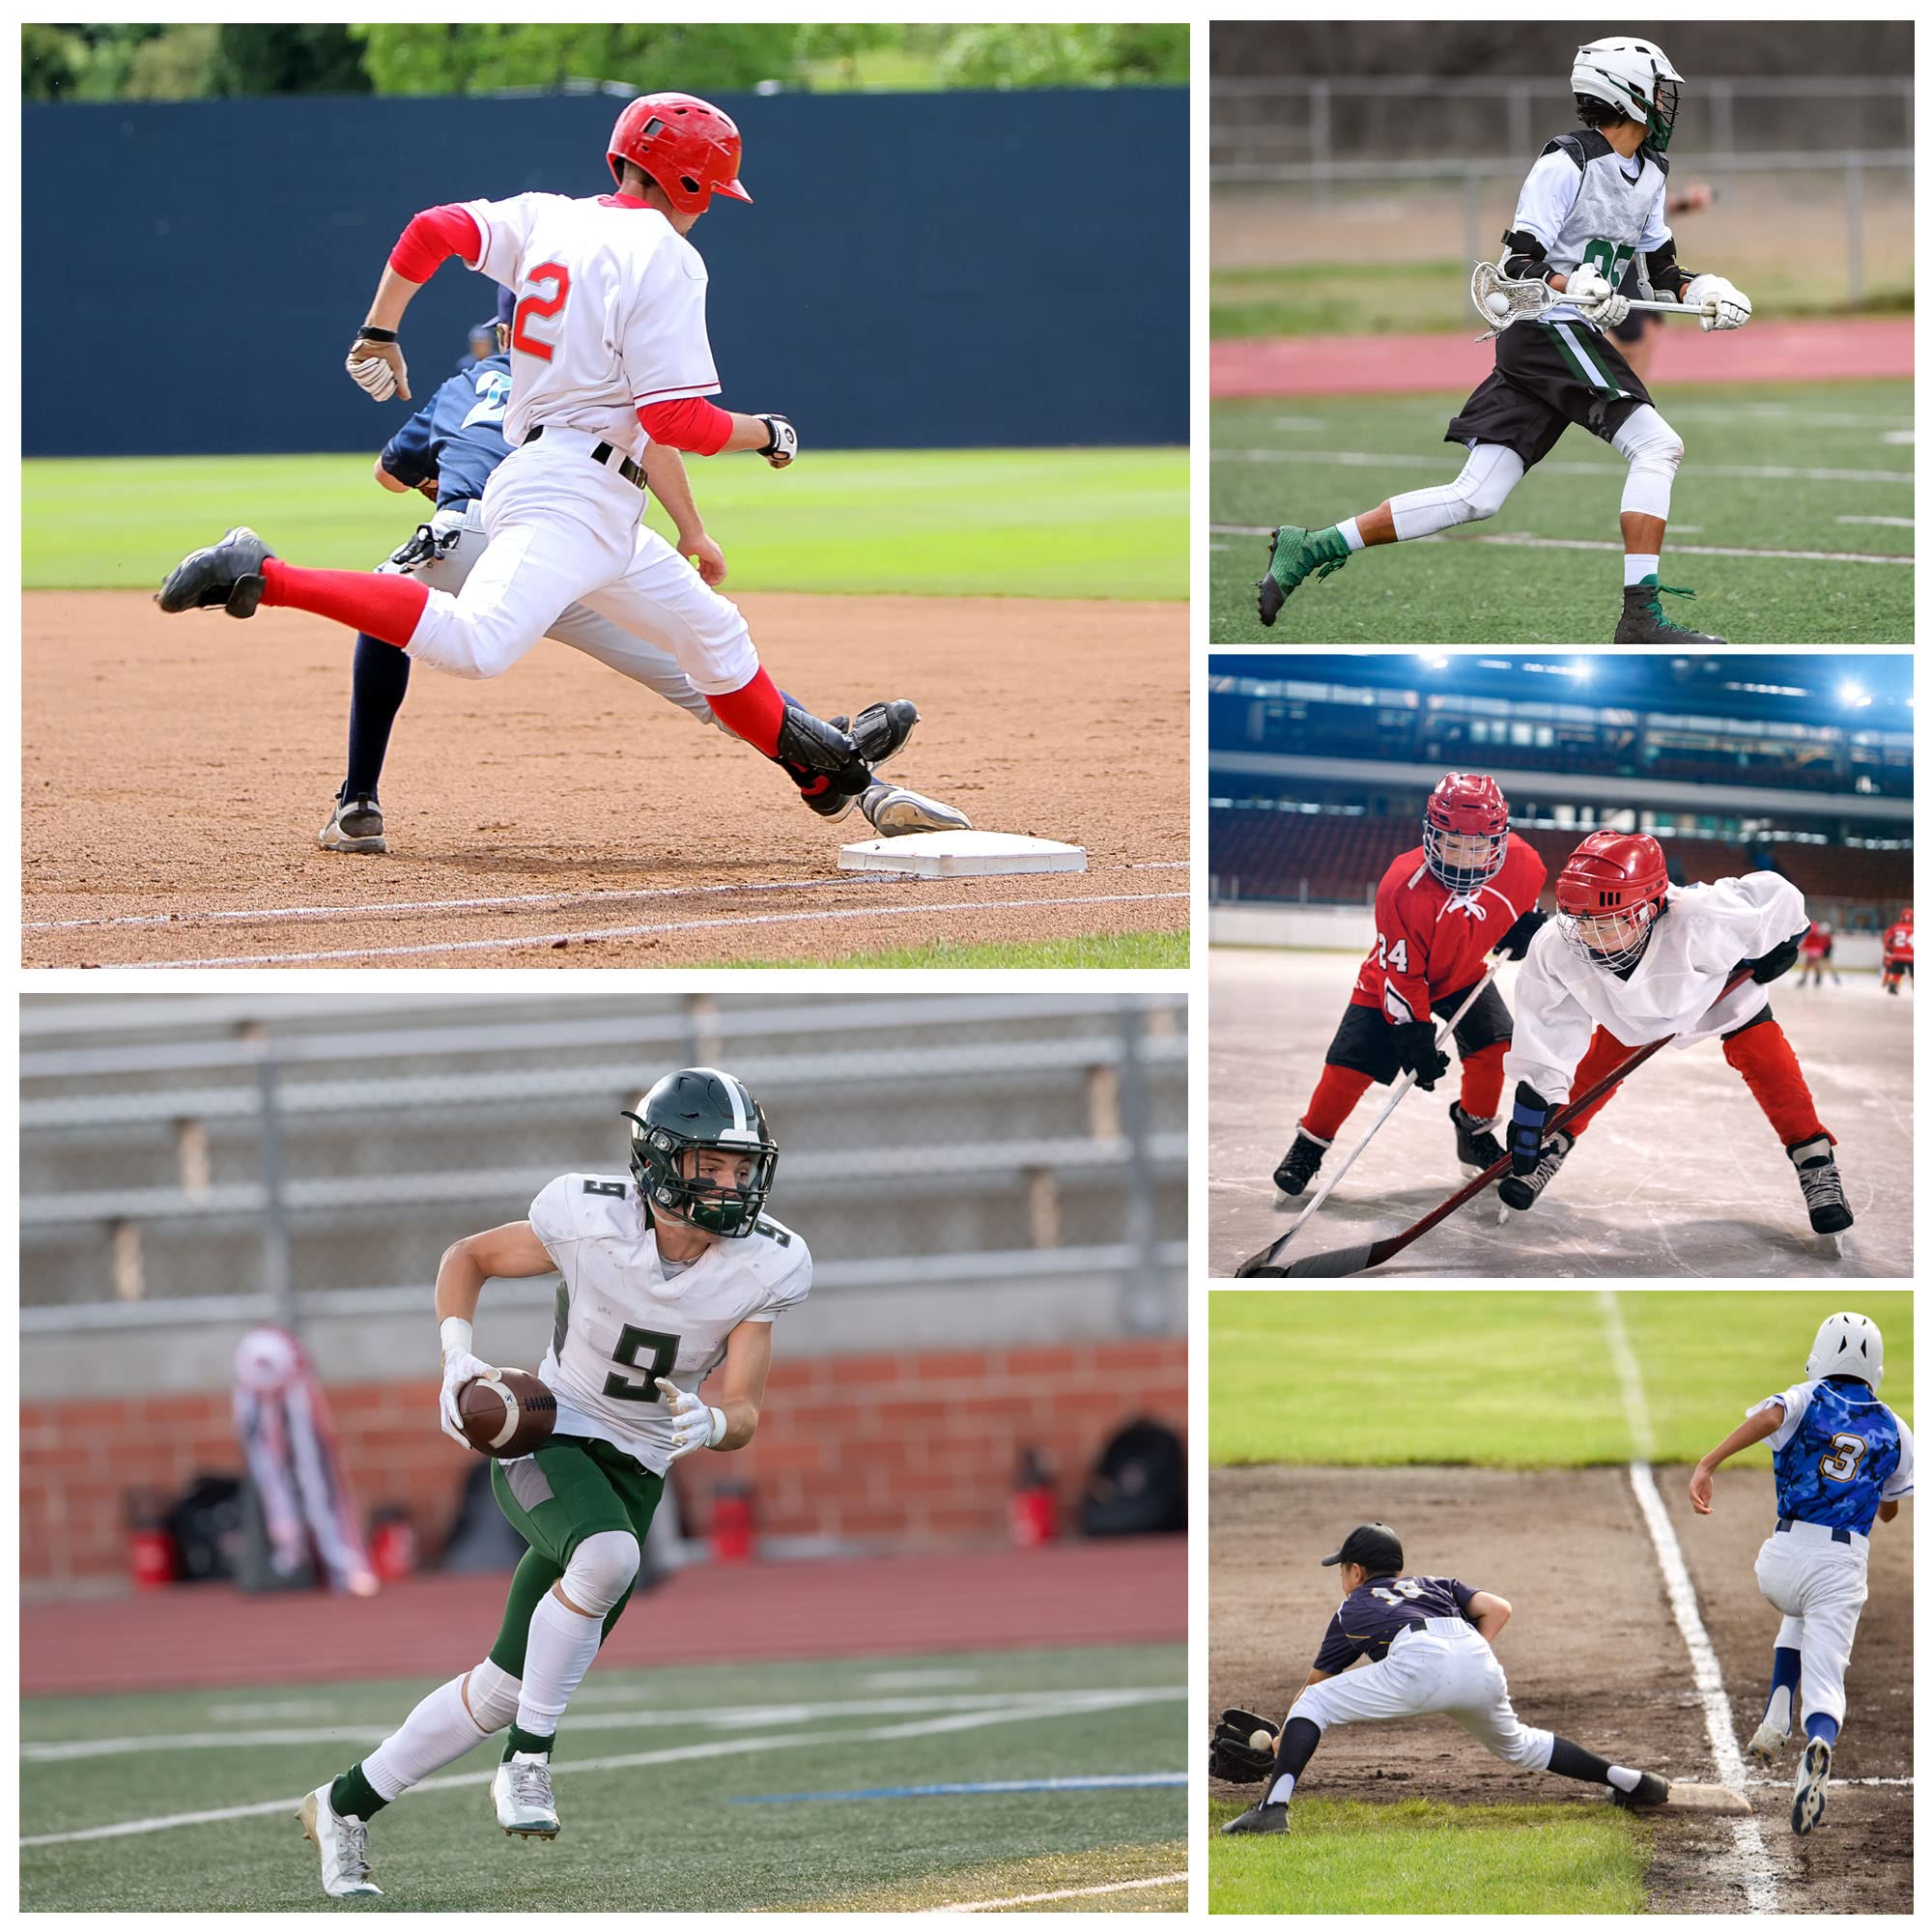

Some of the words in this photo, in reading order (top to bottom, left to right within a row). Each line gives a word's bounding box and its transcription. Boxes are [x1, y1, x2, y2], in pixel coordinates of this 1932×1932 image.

[512, 259, 572, 364] 2
[1378, 931, 1408, 974] 24
[602, 1322, 681, 1403] 9
[1820, 1433, 1868, 1483] 3
